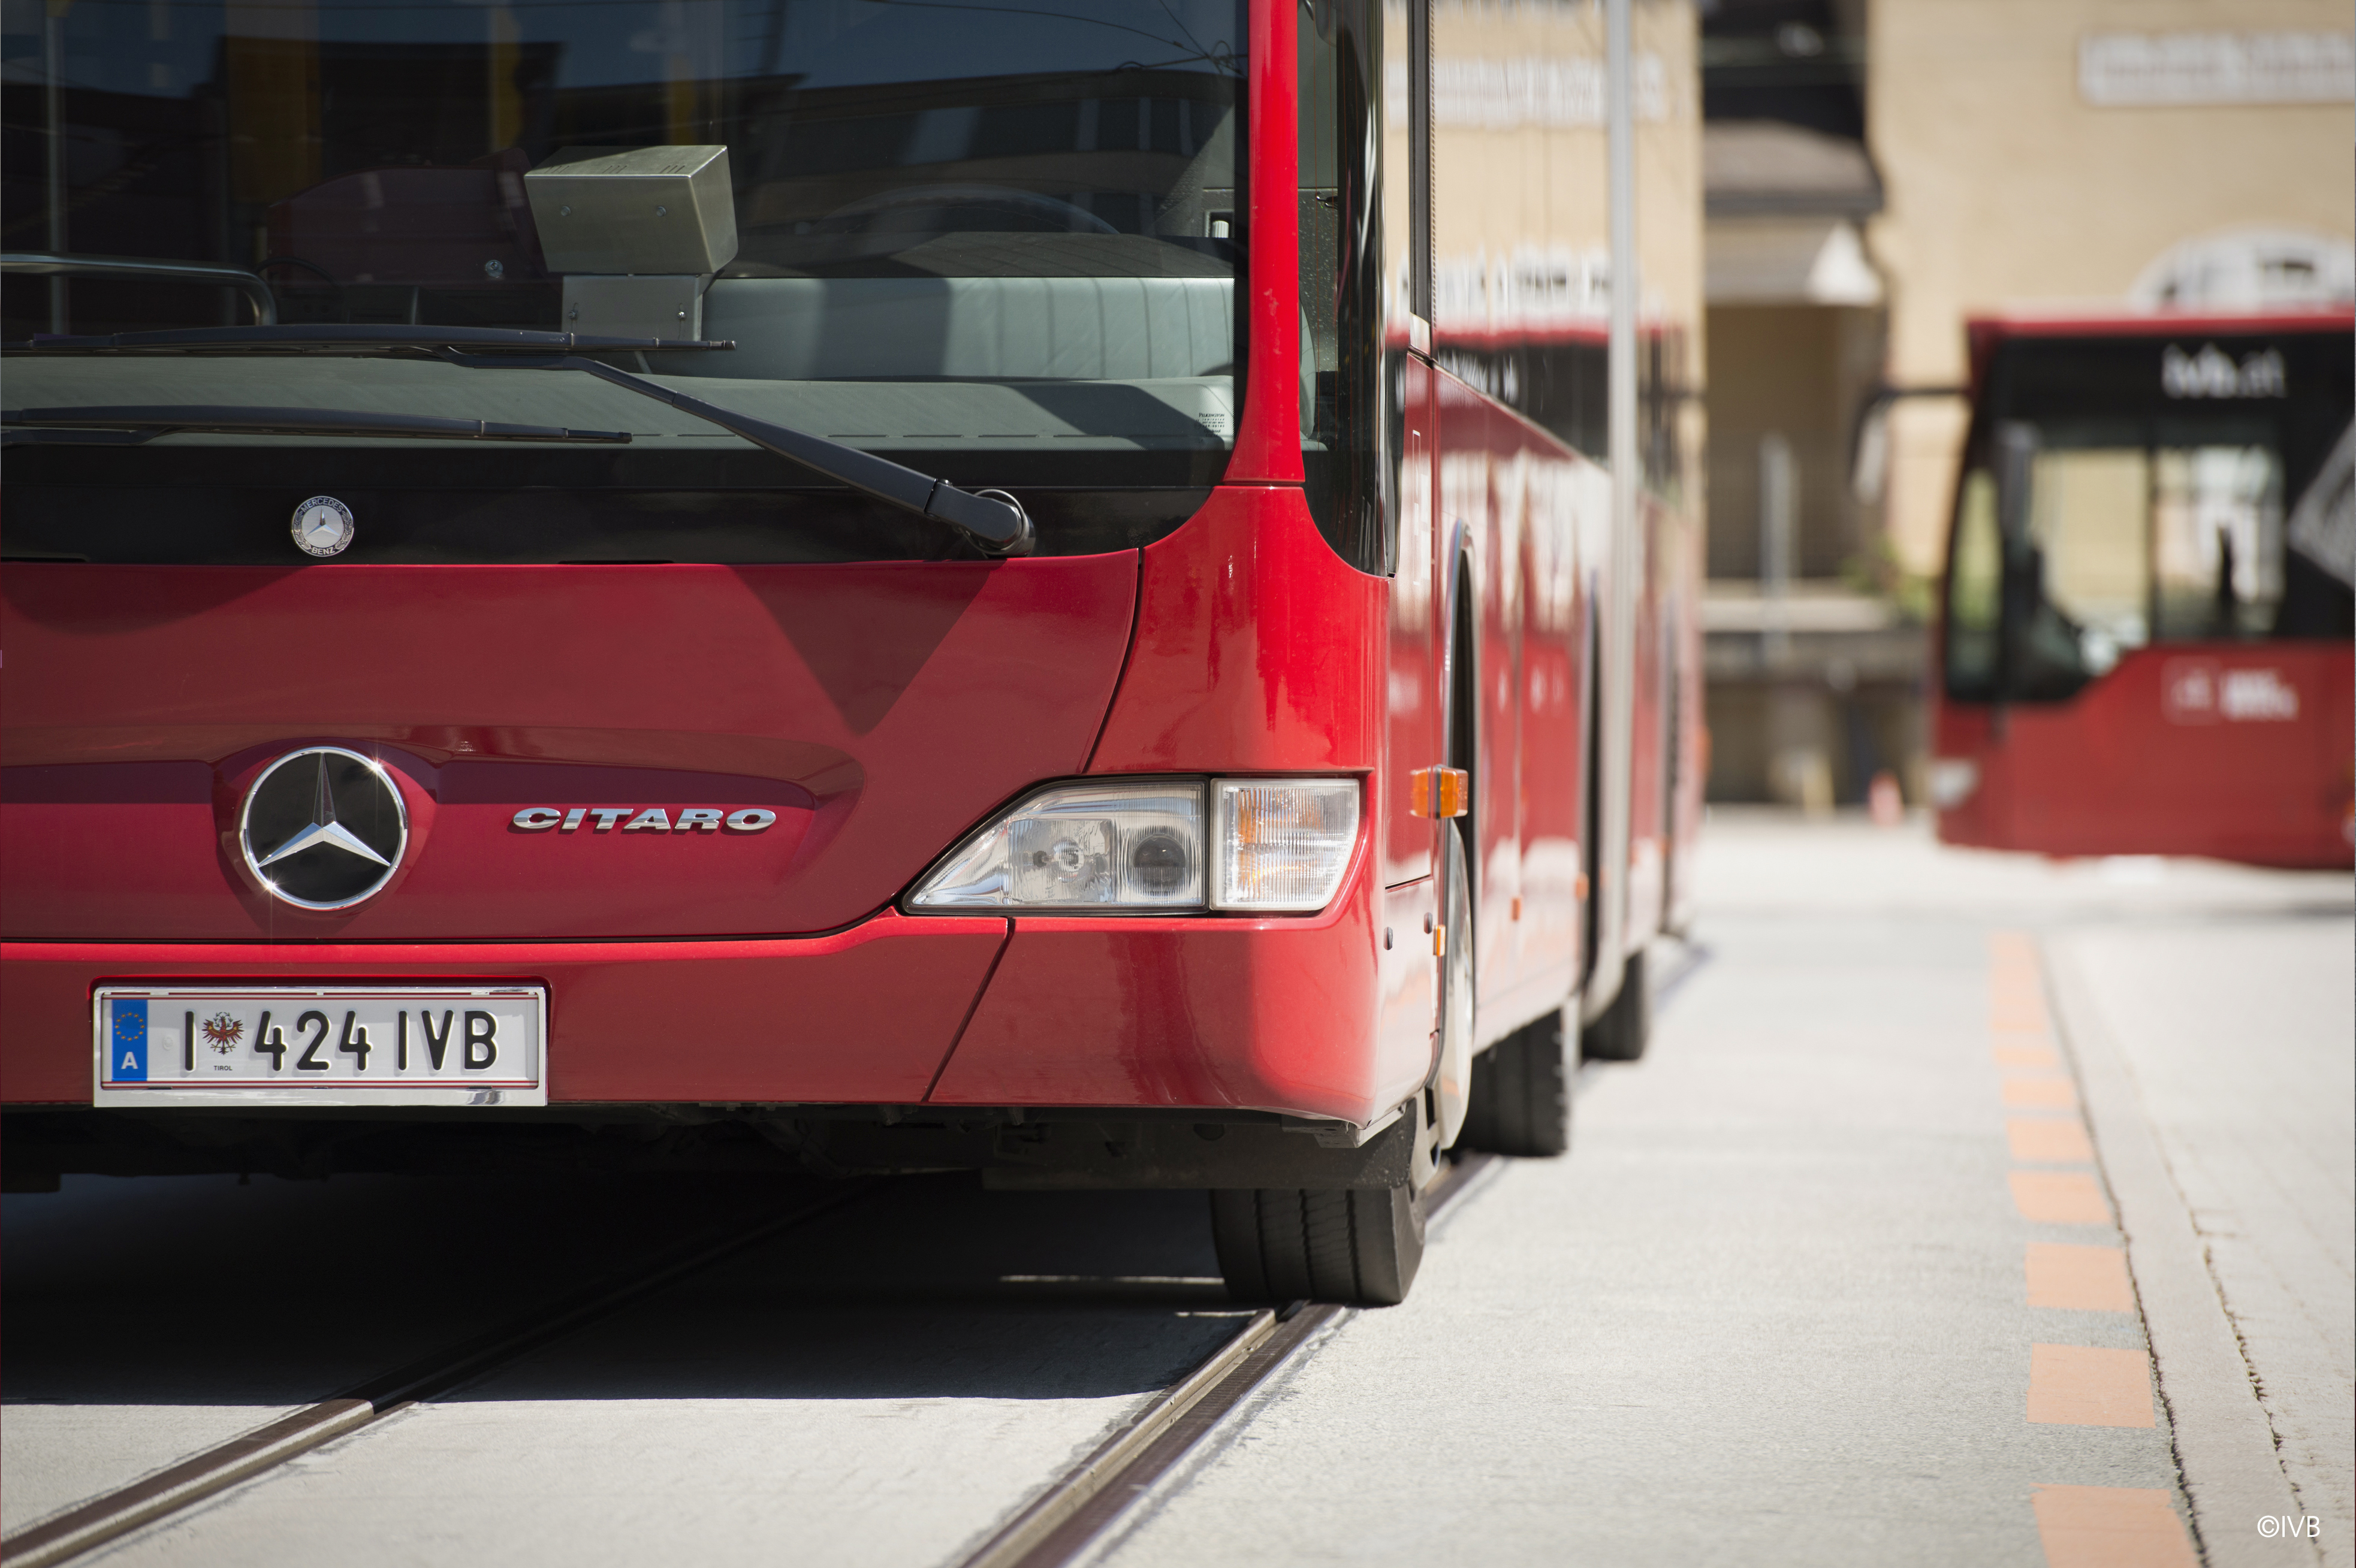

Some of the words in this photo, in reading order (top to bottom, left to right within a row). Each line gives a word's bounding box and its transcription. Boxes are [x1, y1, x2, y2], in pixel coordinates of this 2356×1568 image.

[301, 498, 343, 512] MERCEDES
[312, 546, 335, 555] BENZ
[513, 807, 777, 830] CITARO
[254, 1010, 372, 1071] 424
[399, 1010, 497, 1071] IVB
[121, 1051, 138, 1069] A
